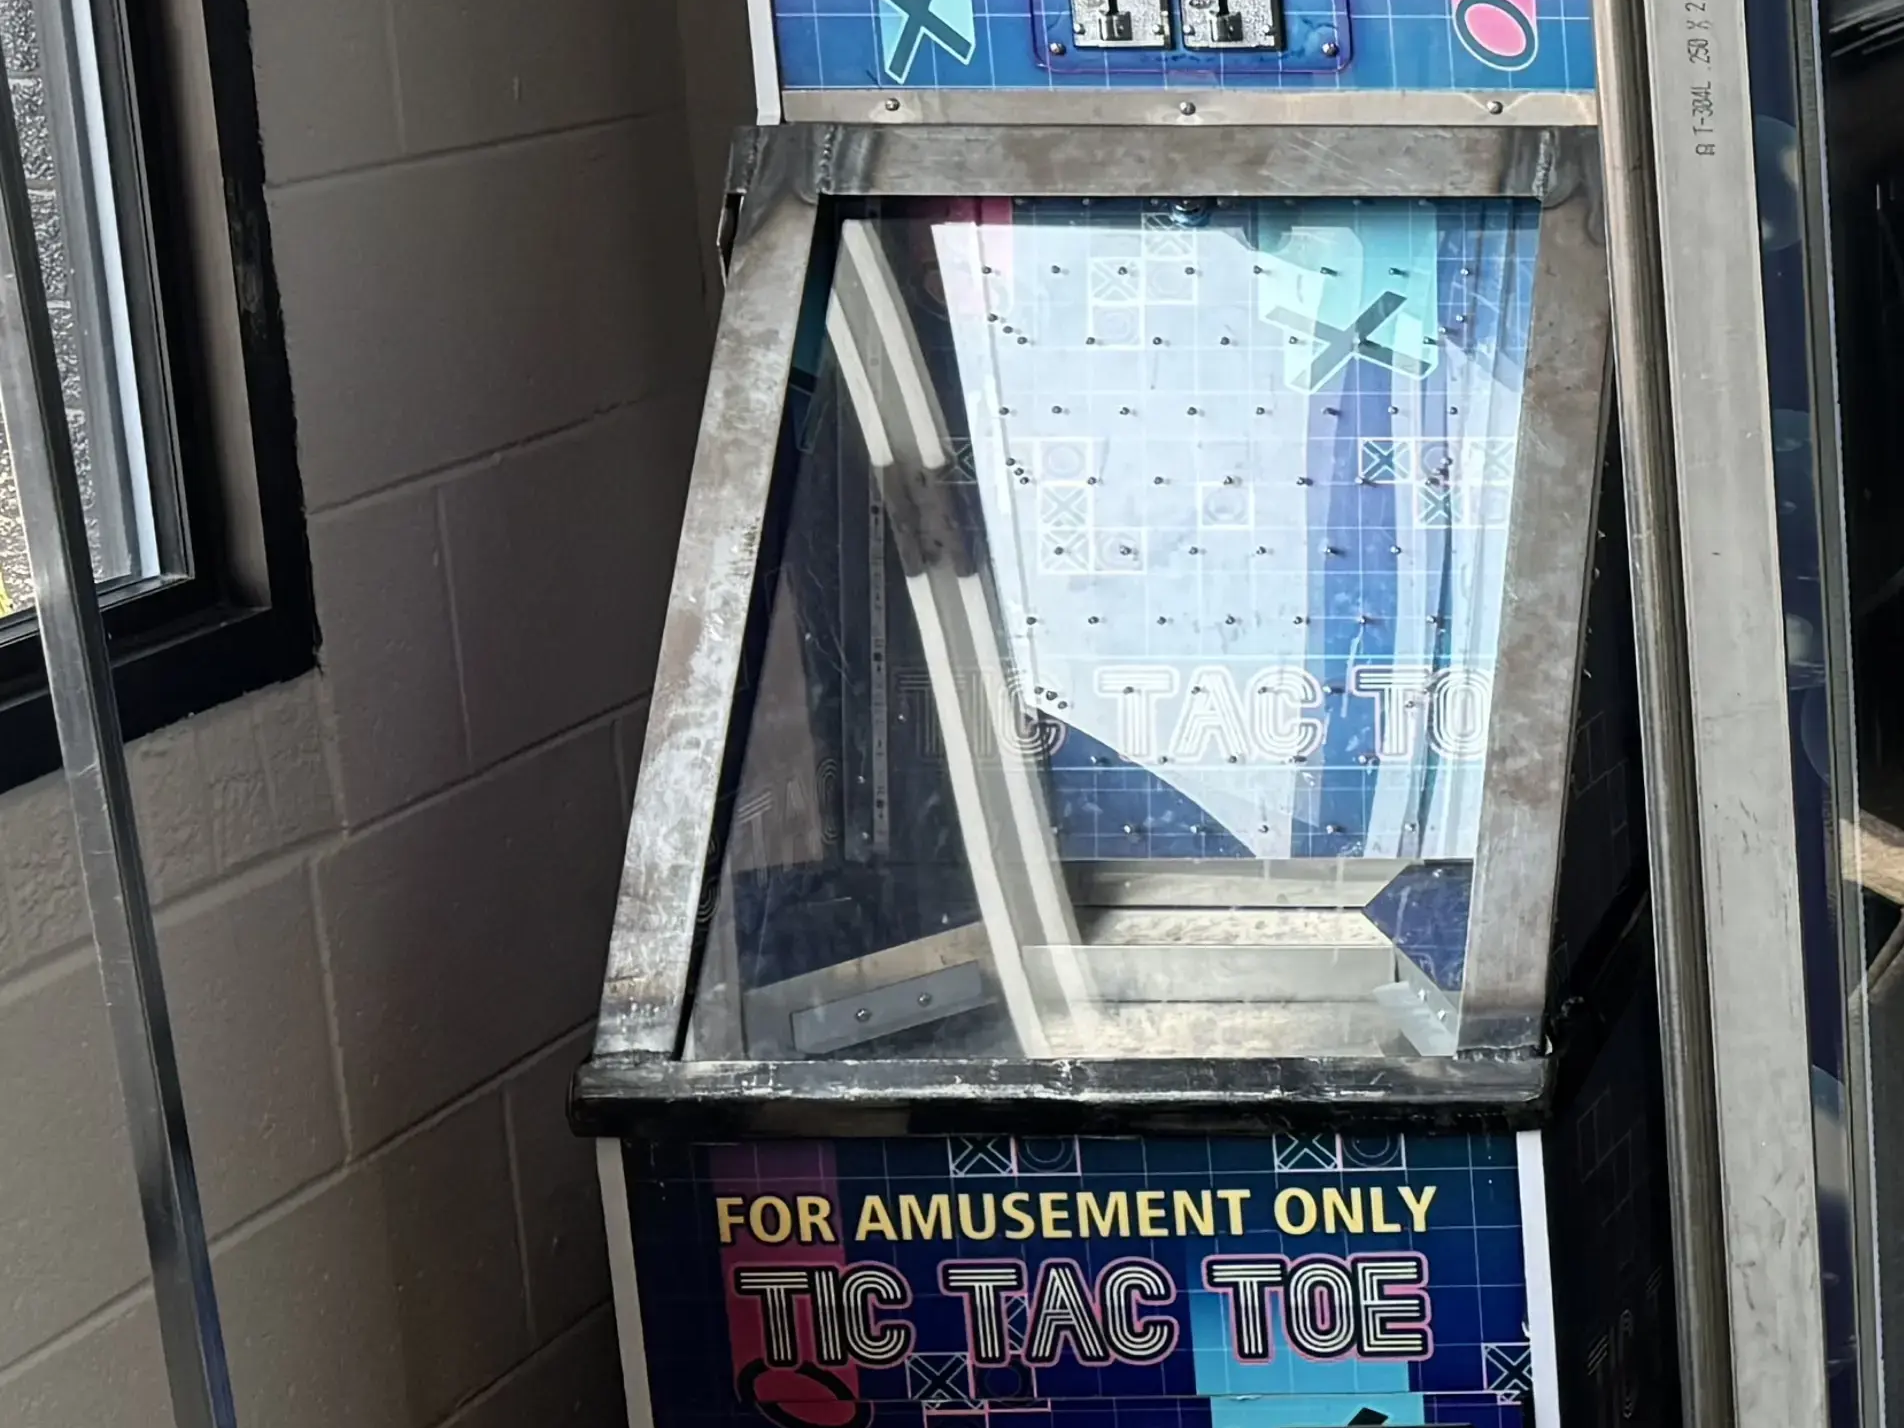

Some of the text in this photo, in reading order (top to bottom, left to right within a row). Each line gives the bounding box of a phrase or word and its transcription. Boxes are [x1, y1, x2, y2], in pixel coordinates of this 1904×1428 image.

[1095, 667, 1324, 760] TAC
[717, 1184, 1437, 1245] FOR AMUSEMENT ONLY
[738, 1258, 1424, 1364] TIC TAC TOE
